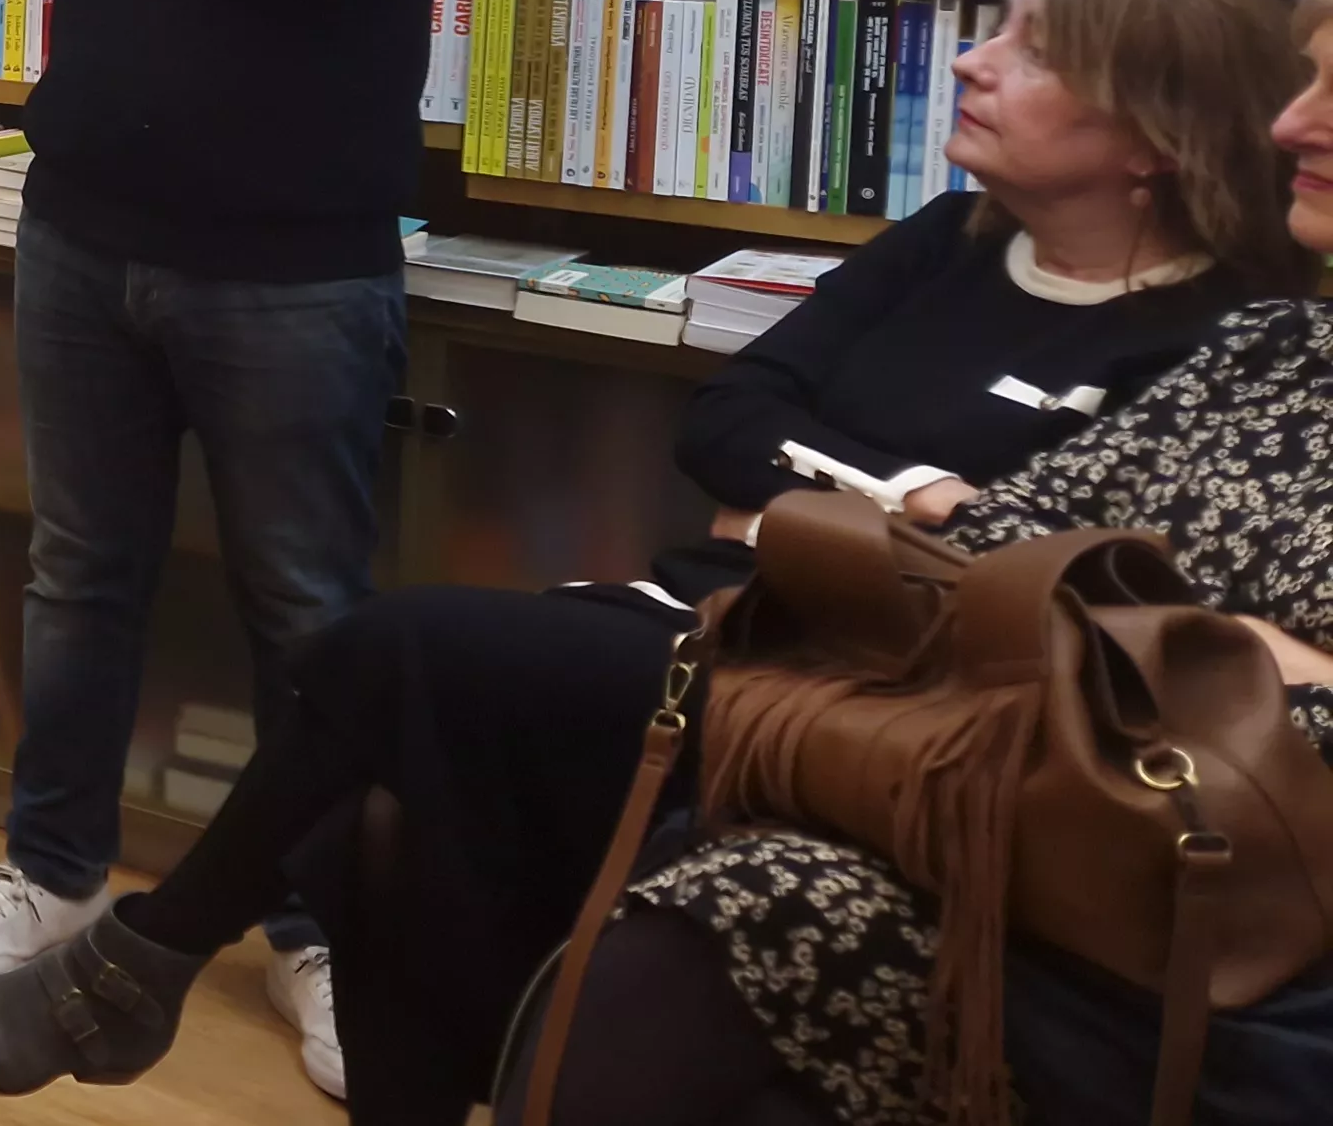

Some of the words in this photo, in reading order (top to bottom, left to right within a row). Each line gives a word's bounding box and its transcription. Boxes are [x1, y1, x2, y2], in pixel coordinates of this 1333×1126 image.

[587, 35, 597, 86] EMOCIONAL
[740, 37, 752, 55] TUS
[779, 13, 794, 67] Altamente
[662, 90, 670, 105] DEL
[663, 70, 673, 90] EGO
[738, 56, 750, 102] SOMBRAS
[777, 69, 791, 111] sensible
[509, 97, 525, 137] ESPINOSA
[528, 99, 543, 138] ESPINOSA
[585, 89, 594, 131] HERENCIA
[681, 76, 696, 133] DIGNIDAD
[660, 107, 670, 151] QUIMERAS
[507, 138, 520, 169] ALBERT
[528, 140, 540, 171] ALBERT
